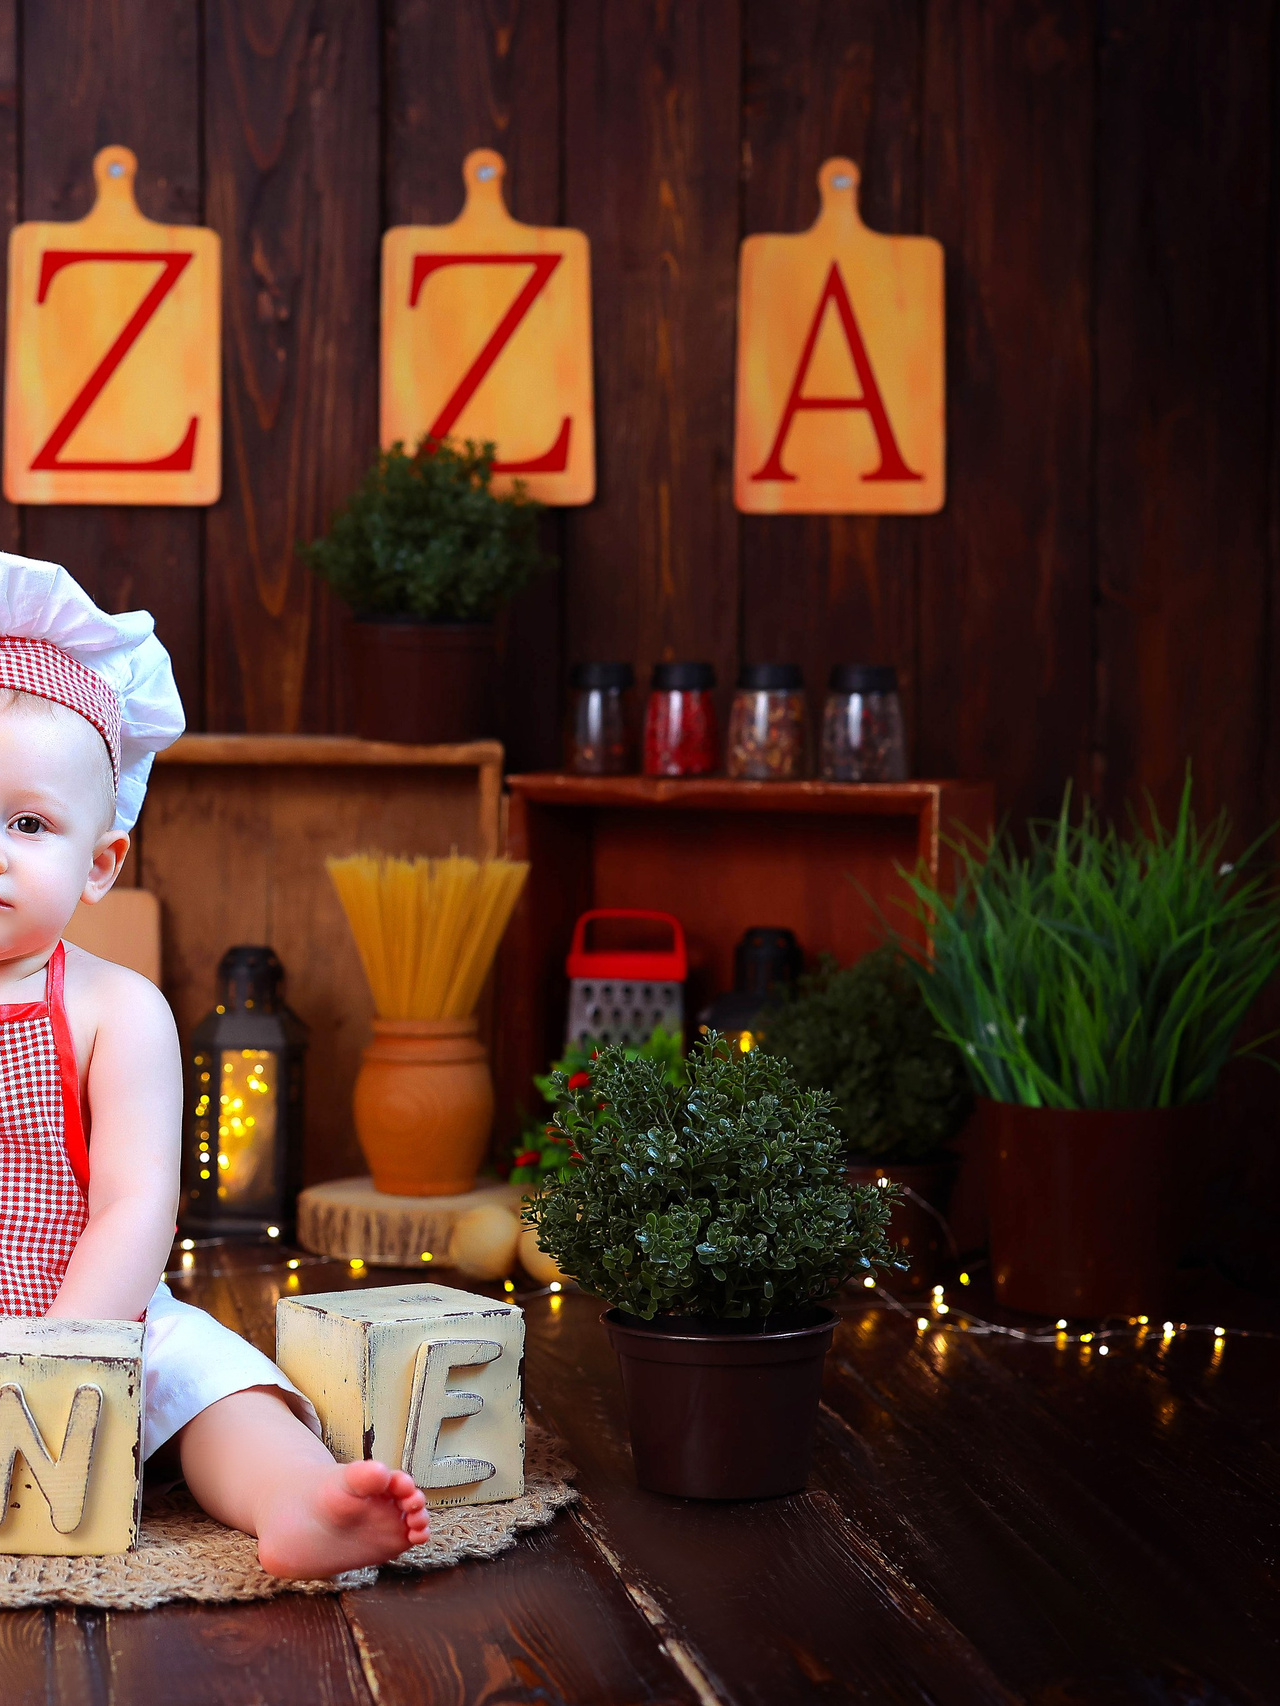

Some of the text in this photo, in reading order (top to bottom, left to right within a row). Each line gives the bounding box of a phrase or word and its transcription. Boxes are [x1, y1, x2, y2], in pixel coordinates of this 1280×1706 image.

[26, 248, 201, 474] Z
[406, 251, 574, 476] Z
[747, 257, 927, 484] A
[401, 1338, 504, 1490] E
